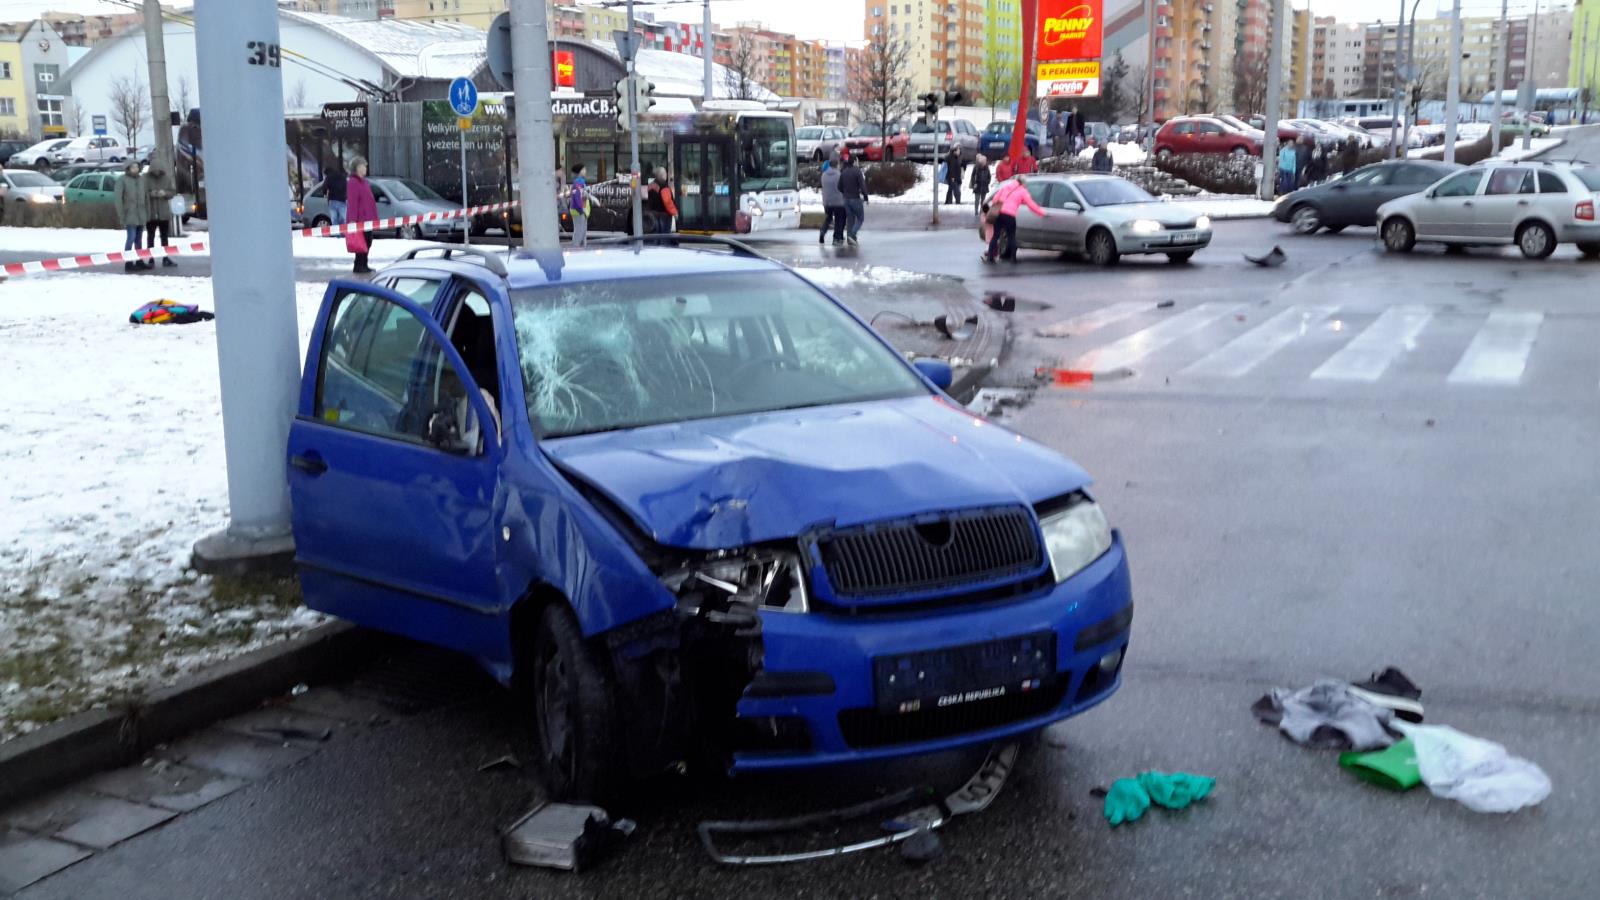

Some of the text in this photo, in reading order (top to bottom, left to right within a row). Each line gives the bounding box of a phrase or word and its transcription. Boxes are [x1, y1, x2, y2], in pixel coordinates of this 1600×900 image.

[1044, 17, 1093, 32] PENNY
[1060, 31, 1086, 39] MARKET
[247, 41, 280, 67] 39
[323, 108, 349, 119] Vesmír
